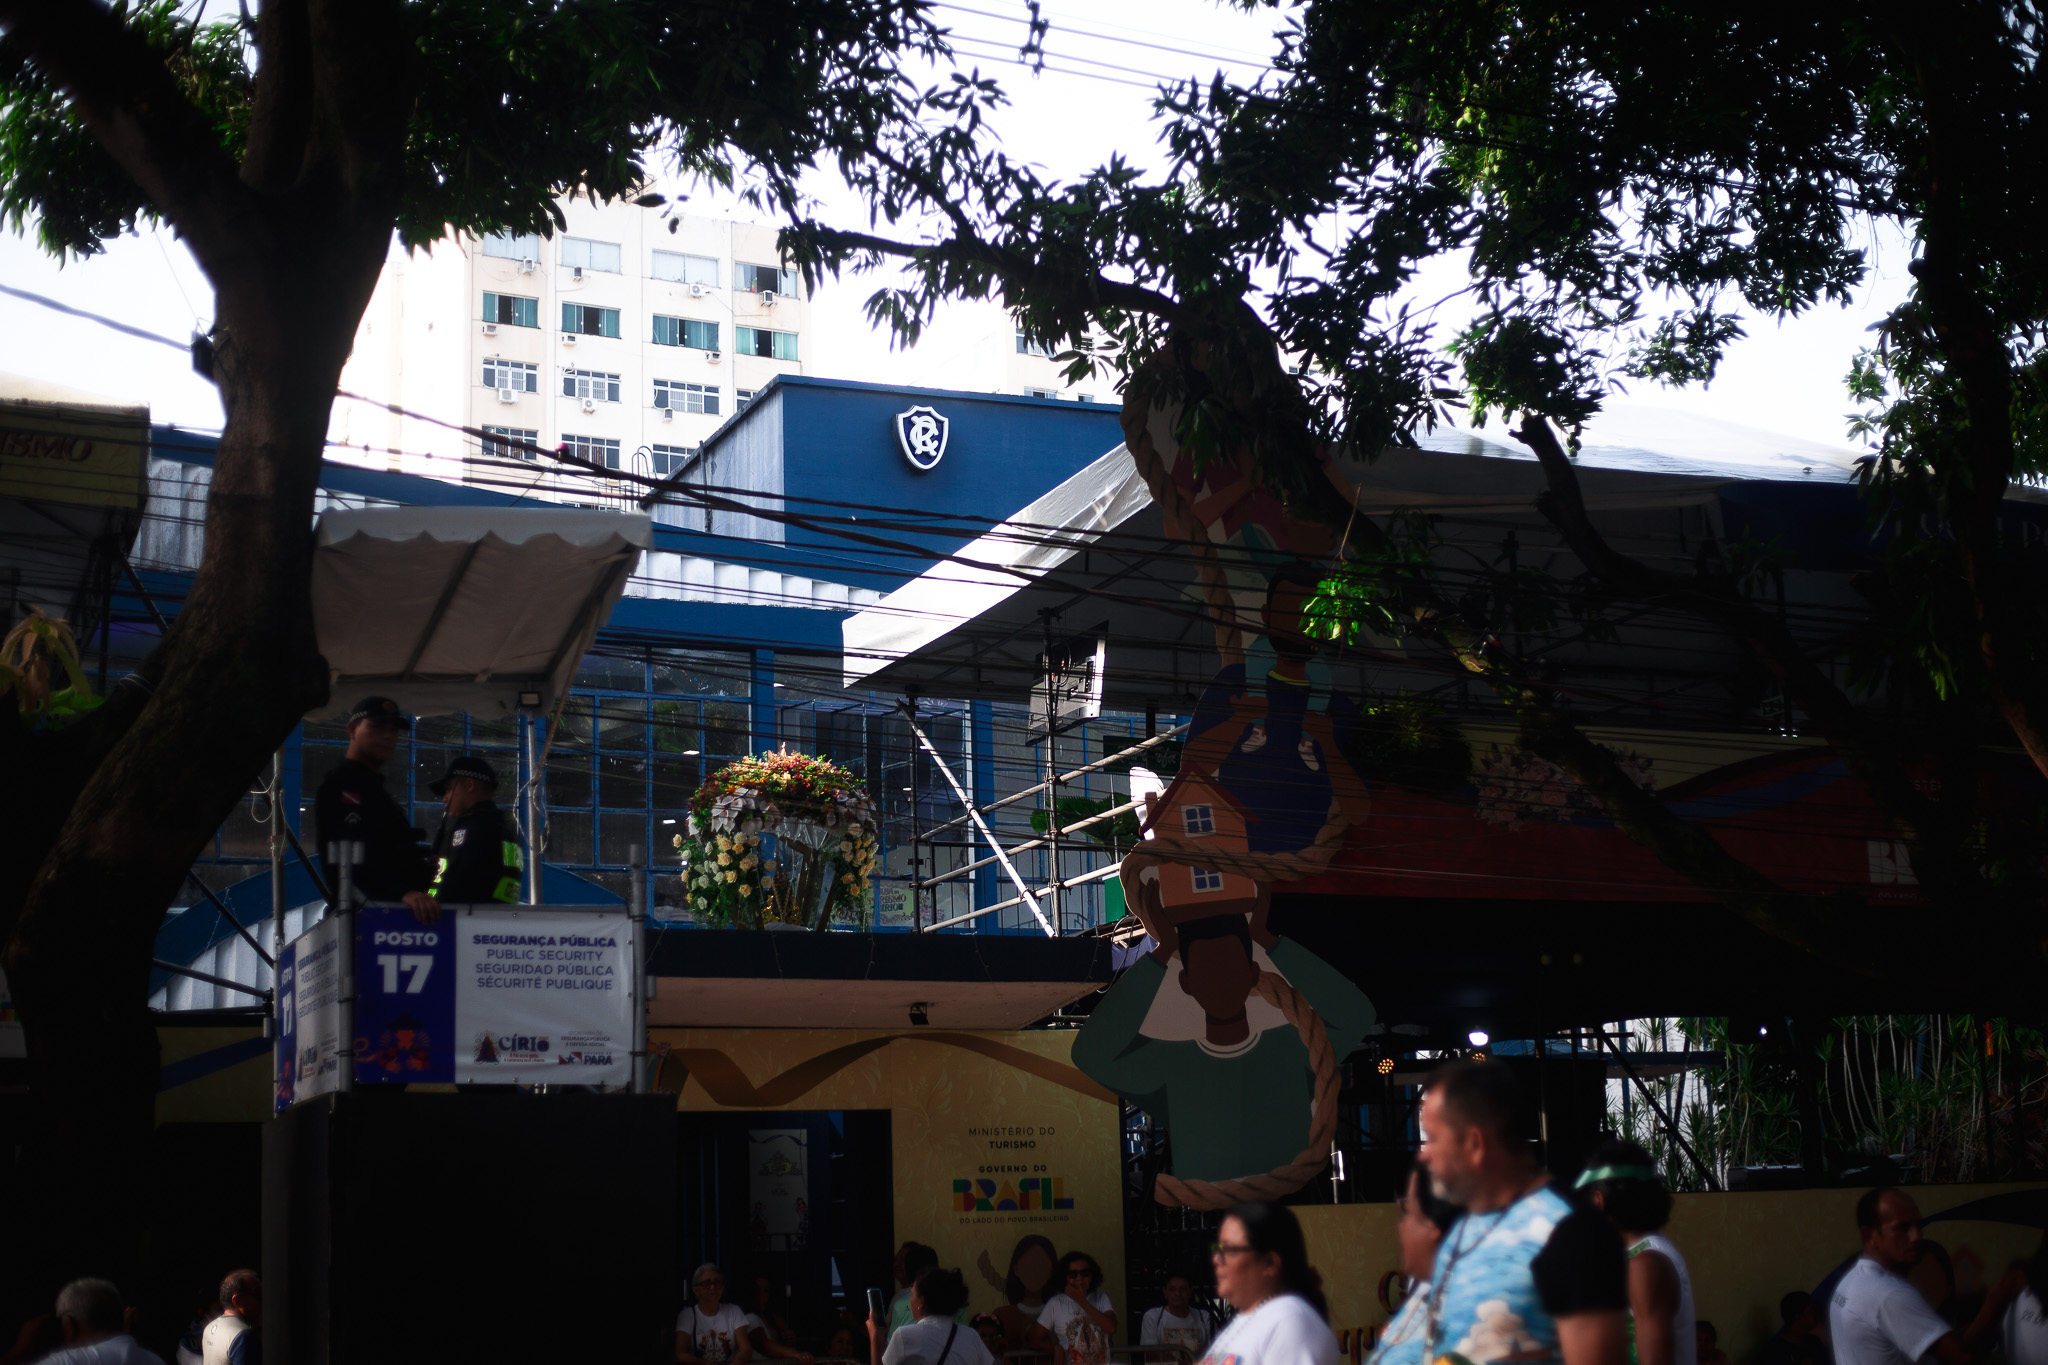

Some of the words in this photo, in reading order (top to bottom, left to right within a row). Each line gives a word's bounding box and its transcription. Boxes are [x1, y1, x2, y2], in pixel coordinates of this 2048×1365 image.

[374, 931, 438, 946] POSTO
[472, 934, 556, 948] SEGURANÇA
[559, 934, 617, 948] PÚBLICA
[486, 949, 535, 960] PUBLIC
[538, 949, 604, 961] SECURITY
[376, 954, 434, 994] 17
[475, 963, 553, 975] SEGURIDAD
[557, 962, 615, 976] PÚBLICA
[476, 976, 543, 989] SÉCURITÉ
[546, 978, 613, 990] PUBLIQUE
[968, 1126, 1034, 1137] MINISTÉRIO
[1039, 1126, 1056, 1136] DO
[988, 1141, 1036, 1149] TURISMO
[978, 1165, 1028, 1173] GOVERNO
[1033, 1165, 1047, 1173] DO
[953, 1177, 1075, 1212] BRASIL
[1029, 1215, 1070, 1223] BRASILEIRO
